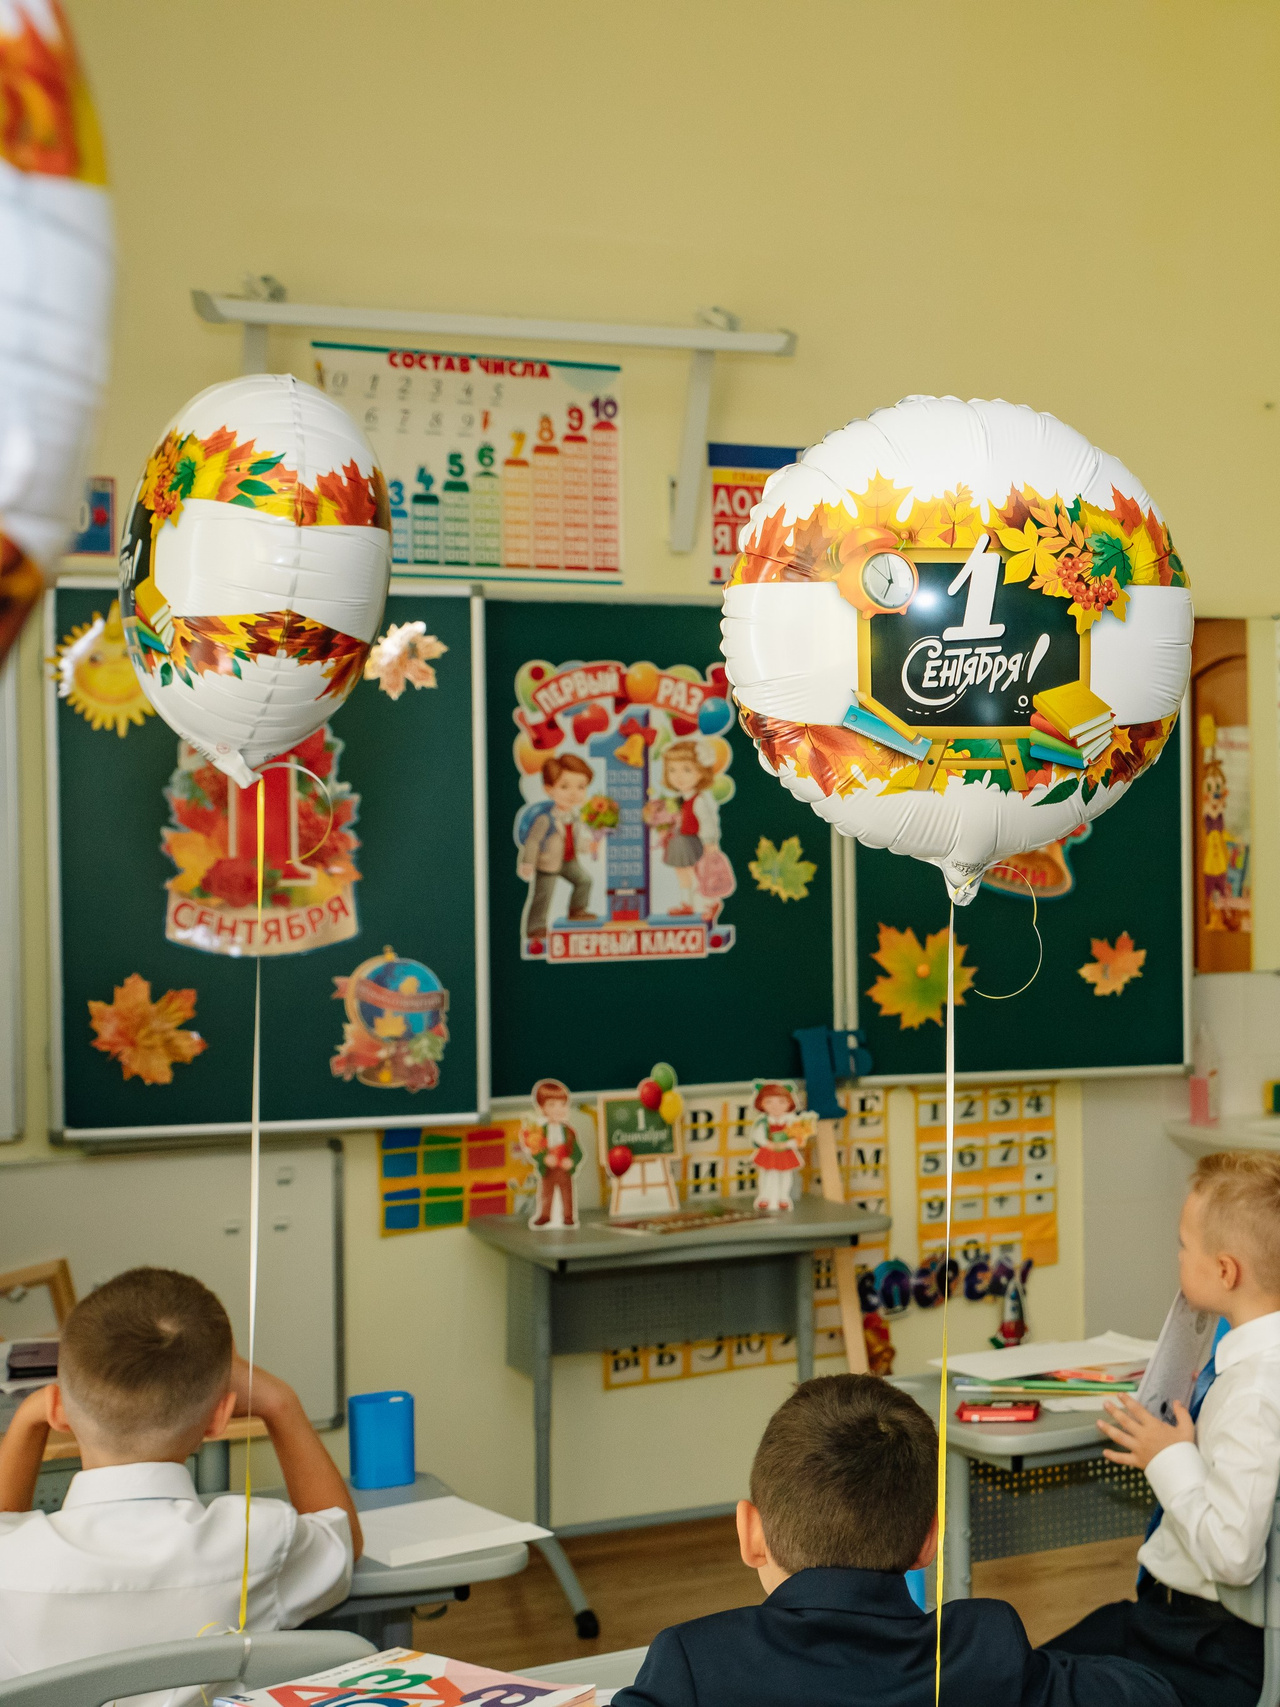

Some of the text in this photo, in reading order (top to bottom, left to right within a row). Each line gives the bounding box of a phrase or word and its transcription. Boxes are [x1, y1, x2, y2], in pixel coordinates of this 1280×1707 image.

[388, 352, 551, 379] СОСТАВ ЧИСЛА
[567, 405, 584, 432] 9
[591, 397, 618, 419] 10
[538, 414, 556, 443] 8
[477, 444, 495, 468] 6
[510, 431, 527, 458] 7
[416, 466, 434, 491] 4
[447, 453, 465, 477] 5
[389, 480, 405, 506] 3
[943, 533, 1006, 641] 1
[535, 666, 704, 714] ПЕРВЫЙ РАЗ
[173, 895, 350, 945] СЕНТЯБРЯ
[552, 933, 565, 957] В
[569, 930, 638, 957] ПЕРВЫЙ
[961, 1095, 976, 1118] 2
[994, 1092, 1012, 1116] 3
[1026, 1090, 1043, 1113] 4
[690, 1109, 715, 1142] В
[922, 1136, 1047, 1174] 5 6 7 8
[926, 1195, 945, 1219] 9
